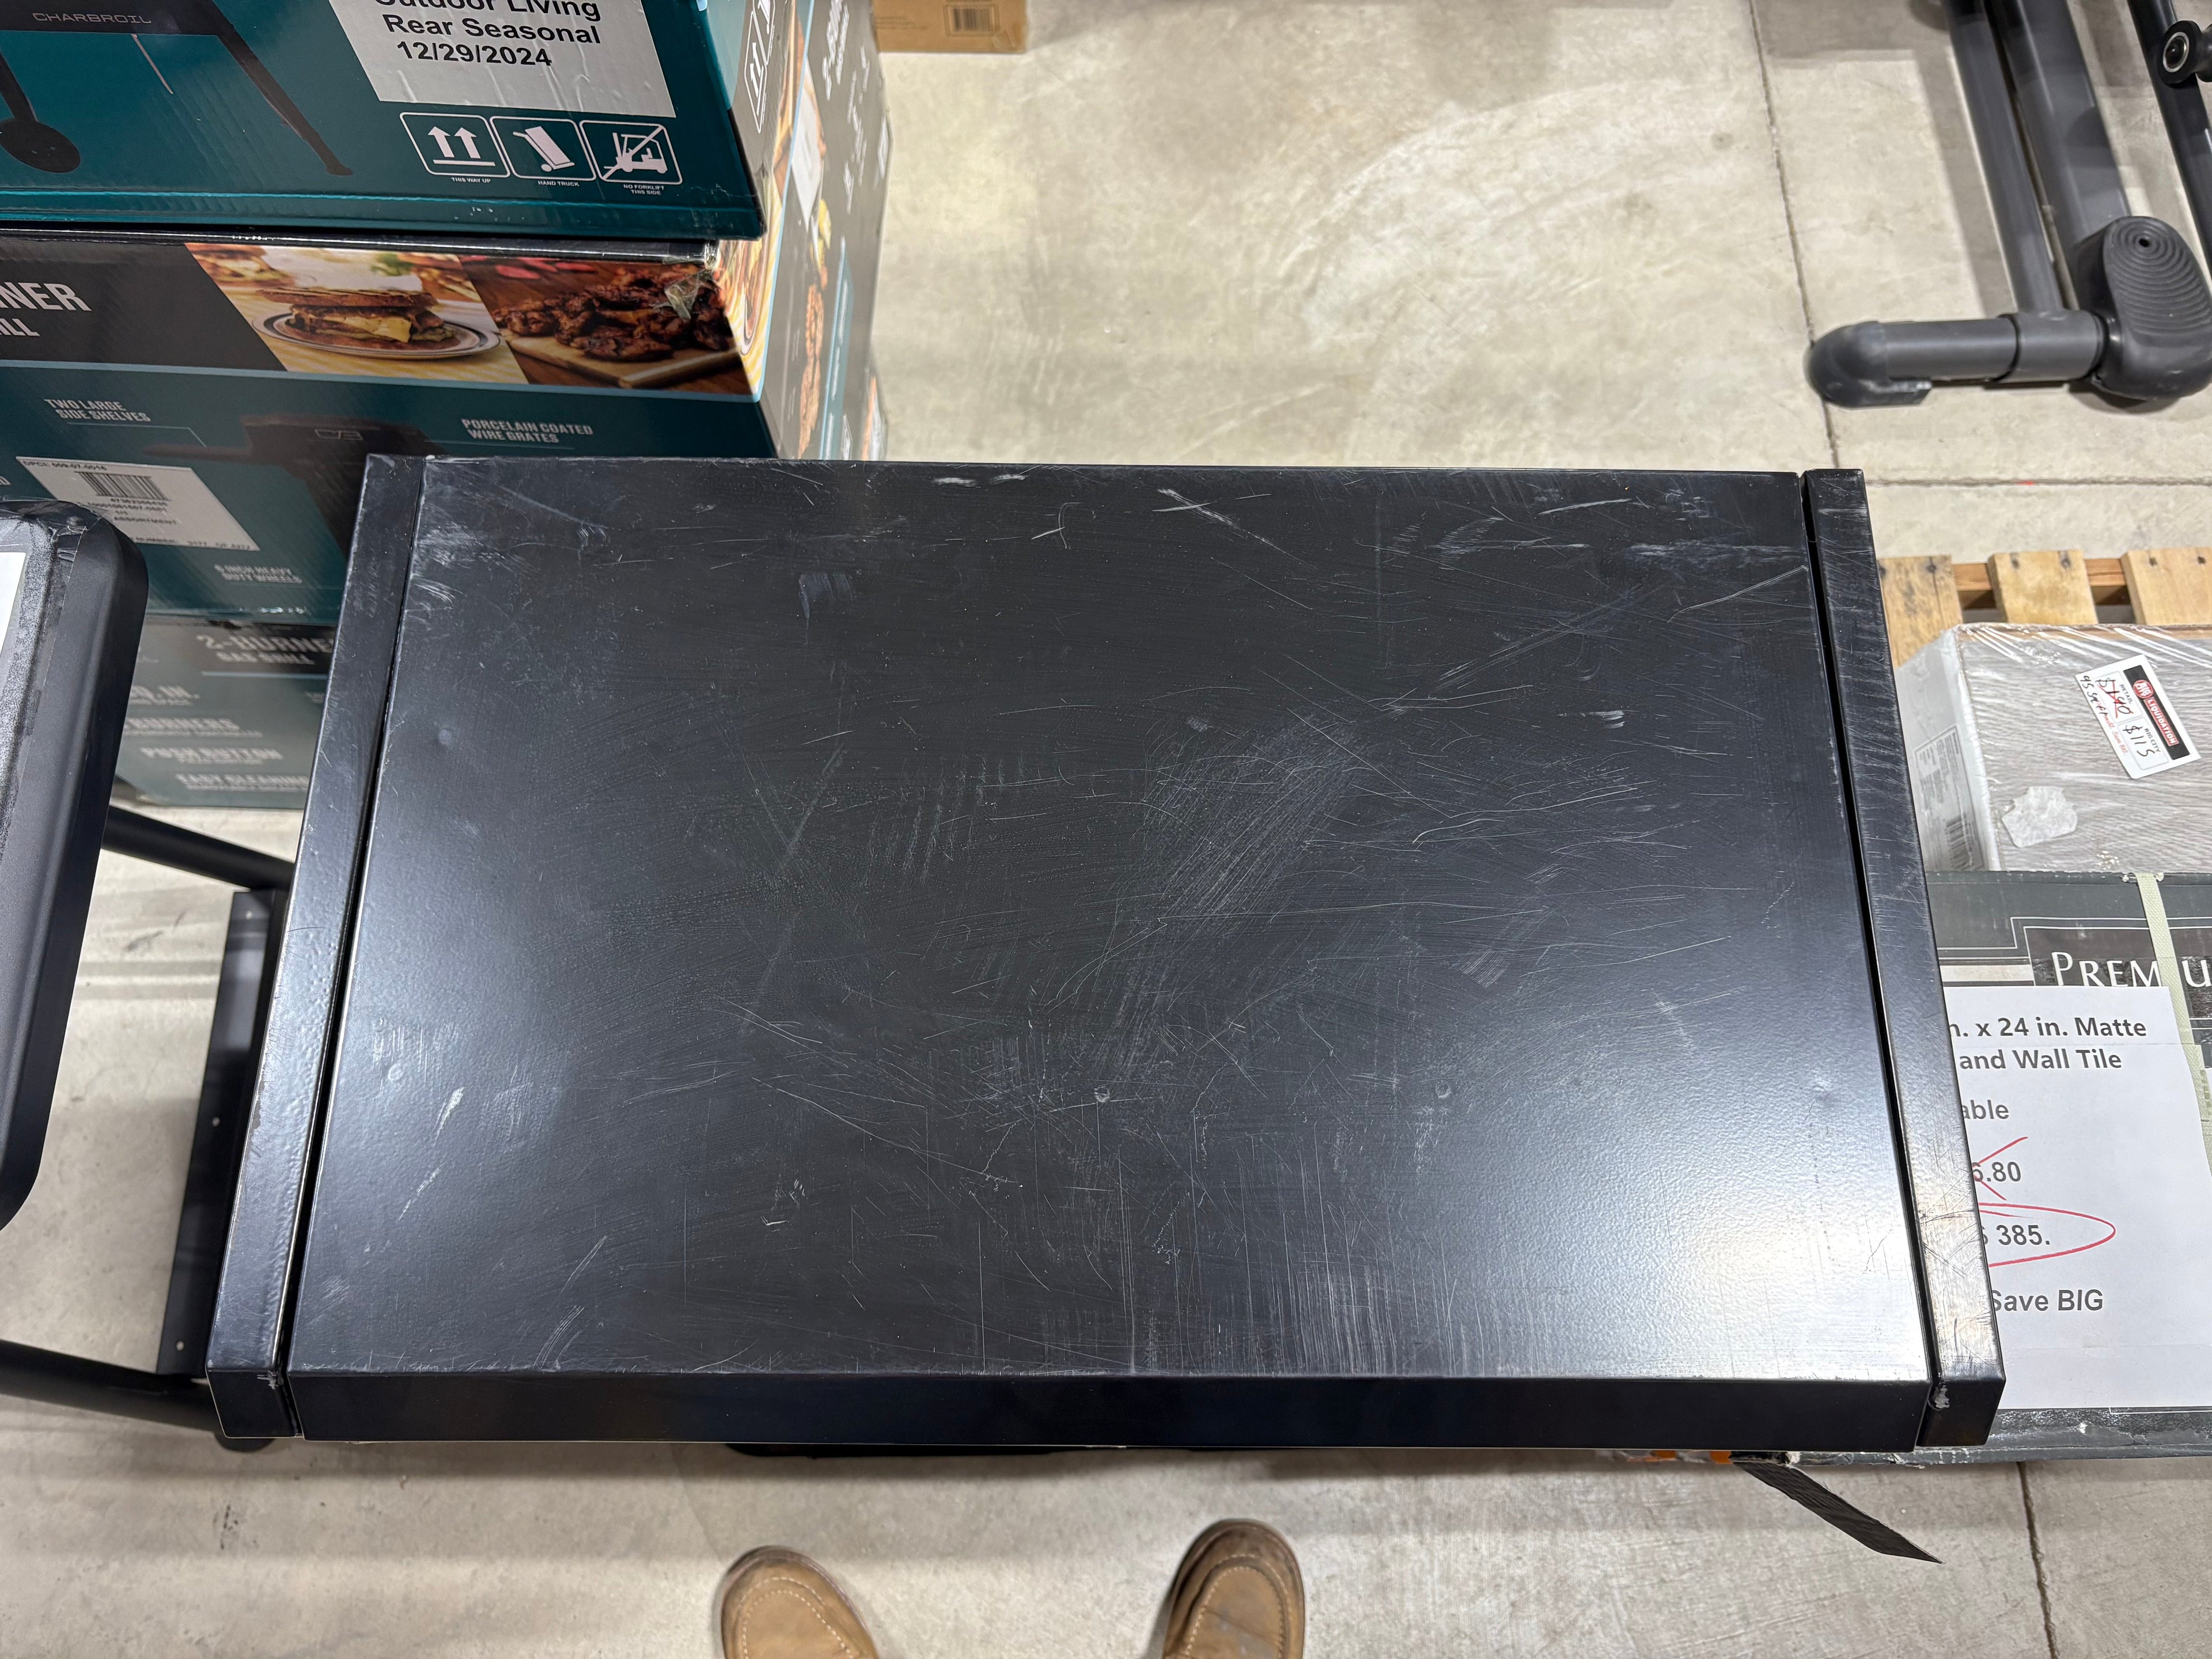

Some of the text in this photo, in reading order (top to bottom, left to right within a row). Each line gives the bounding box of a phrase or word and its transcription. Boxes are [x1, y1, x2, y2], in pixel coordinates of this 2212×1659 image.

[32, 13, 151, 24] CHARBROIL
[376, 0, 601, 21] uoor Living
[382, 14, 601, 44] Rear Seasonal
[397, 41, 552, 66] 12/29/2024
[0, 282, 92, 311] NER
[0, 318, 41, 336] ILL
[44, 399, 126, 411] TWO LARGE
[55, 410, 151, 422] SIDE SHELVES
[461, 419, 593, 435] PORCELAIN COATED
[467, 429, 559, 443] WIRE GRATES
[196, 635, 334, 653] 2-BURNE
[2119, 684, 2133, 704] RETAIL
[2146, 698, 2177, 744] LIQUIDATION
[2123, 725, 2155, 757] $115
[2144, 728, 2161, 752] BIG CITY
[2051, 952, 2212, 987] PREMU
[1975, 1023, 1992, 1036] x
[1998, 1017, 2029, 1036] 24
[2036, 1017, 2069, 1036] in.
[2074, 1017, 2147, 1036] Matte
[1959, 1048, 2122, 1069] and Wall Tile
[1996, 1225, 2050, 1245] 385.
[1991, 1289, 2103, 1312] Save BIG
